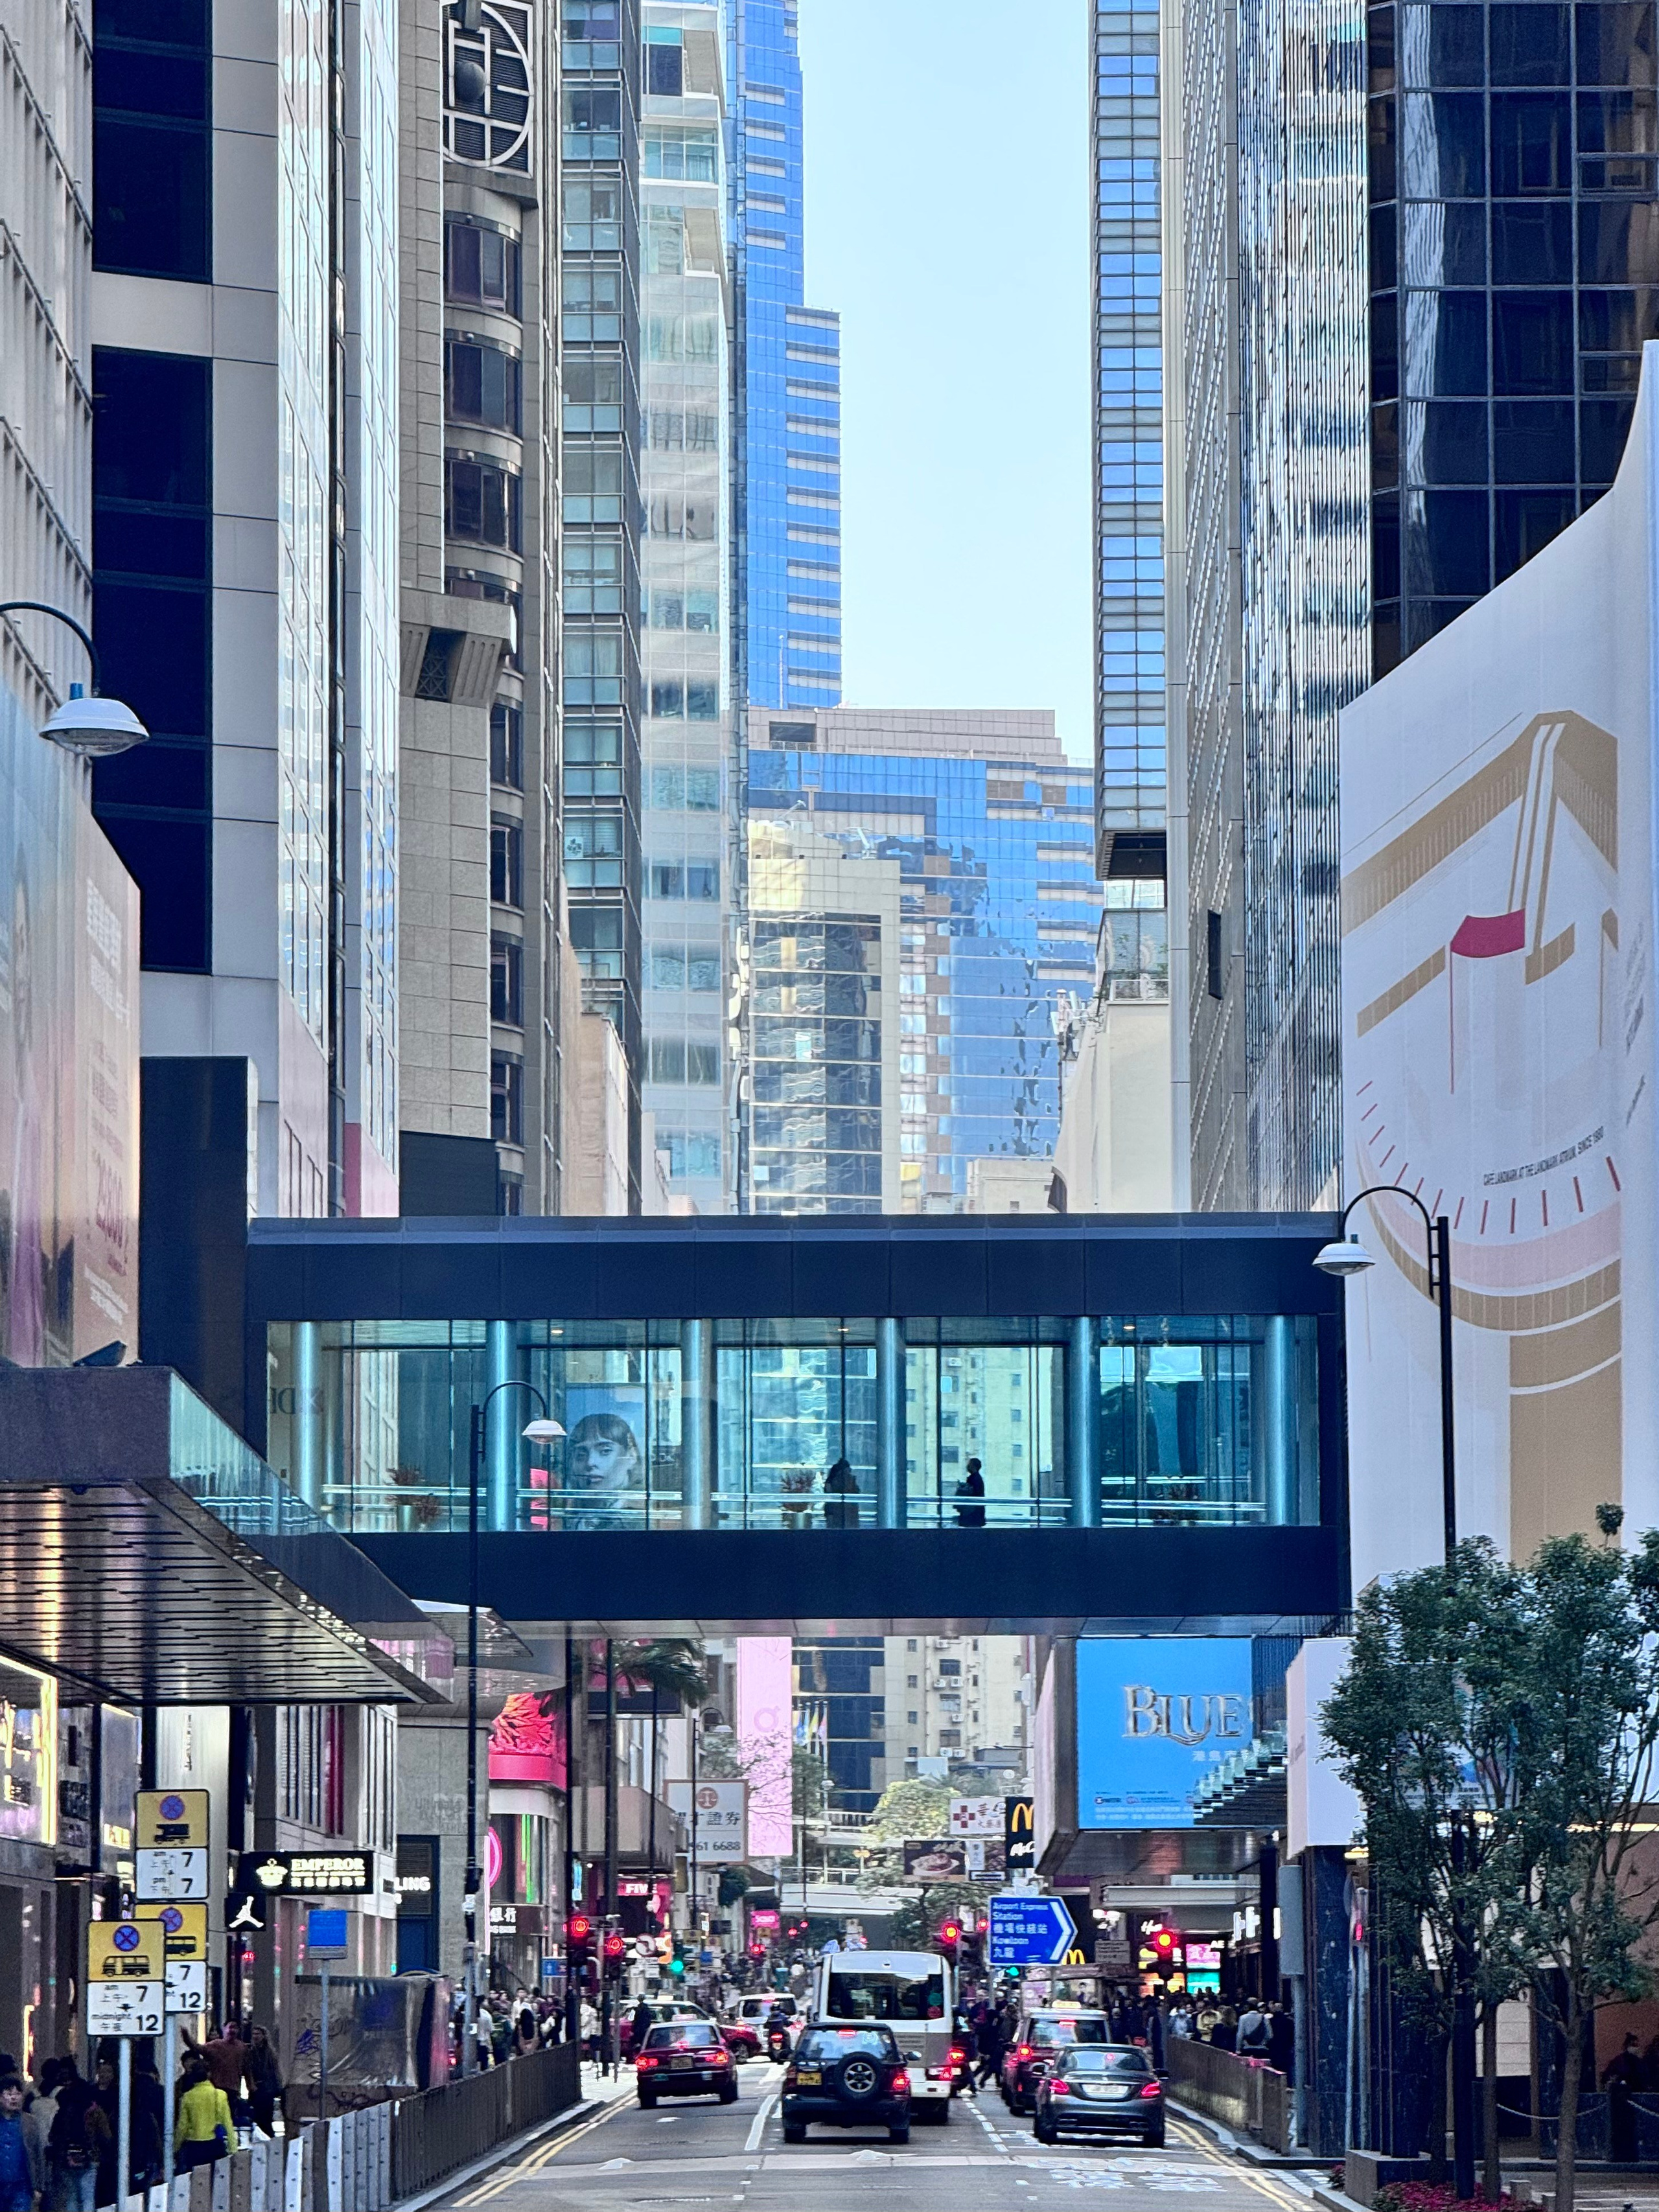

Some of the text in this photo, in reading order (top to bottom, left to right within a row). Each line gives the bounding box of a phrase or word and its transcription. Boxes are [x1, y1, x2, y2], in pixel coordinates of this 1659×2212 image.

[1121, 1684, 1242, 1745] BLUE
[713, 1841, 741, 1851] 6688
[181, 1851, 194, 1867] 7
[291, 1858, 365, 1871] EMPEROR
[181, 1878, 194, 1894] 7
[393, 1876, 431, 1891] LING
[992, 1911, 1024, 1920] Station
[992, 1935, 1029, 1944] Kowloon
[179, 1964, 191, 1981] 7
[135, 1985, 148, 2002] 7
[180, 1992, 202, 2009] 12
[135, 2014, 159, 2032] 12
